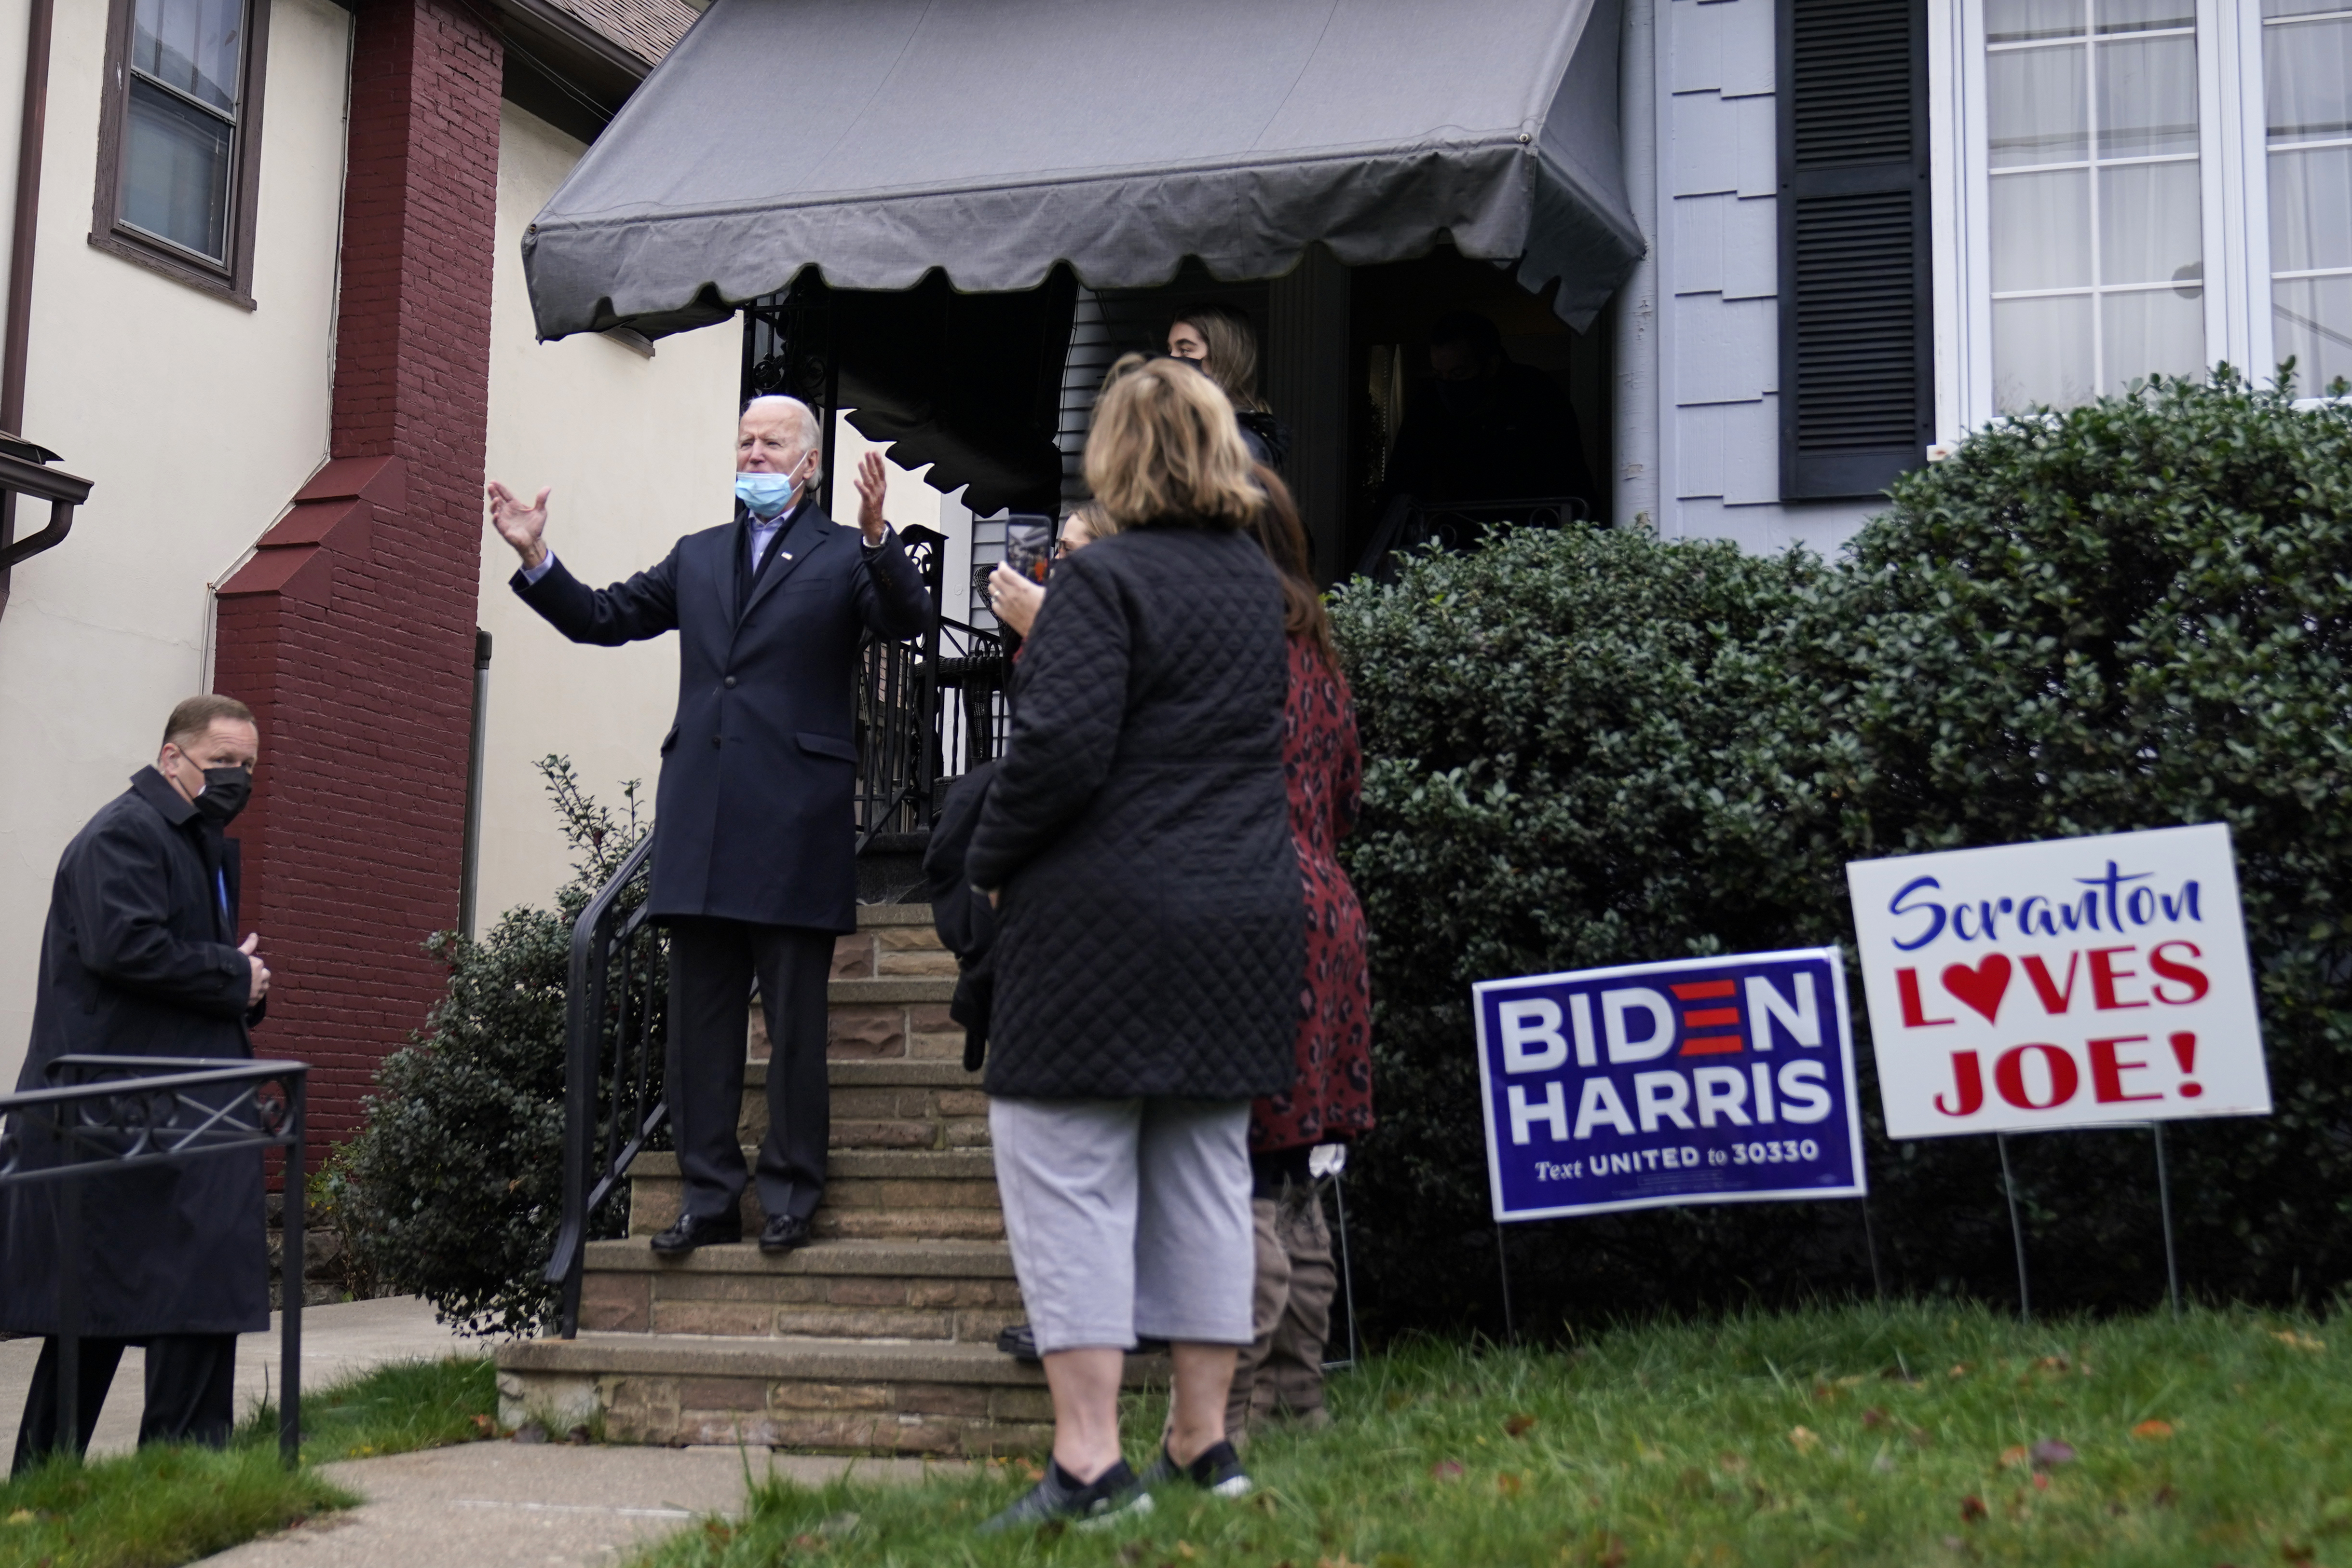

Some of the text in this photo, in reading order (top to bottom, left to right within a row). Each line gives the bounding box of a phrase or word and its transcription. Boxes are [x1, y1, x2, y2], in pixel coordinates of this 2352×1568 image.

[1888, 859, 2202, 952] Scranton
[1498, 971, 1822, 1074] BIDEN
[1507, 1059, 1832, 1145] HARRIS
[1933, 1031, 2204, 1117] JOE!
[1535, 1139, 1819, 1181] Text UNITED to 30330
